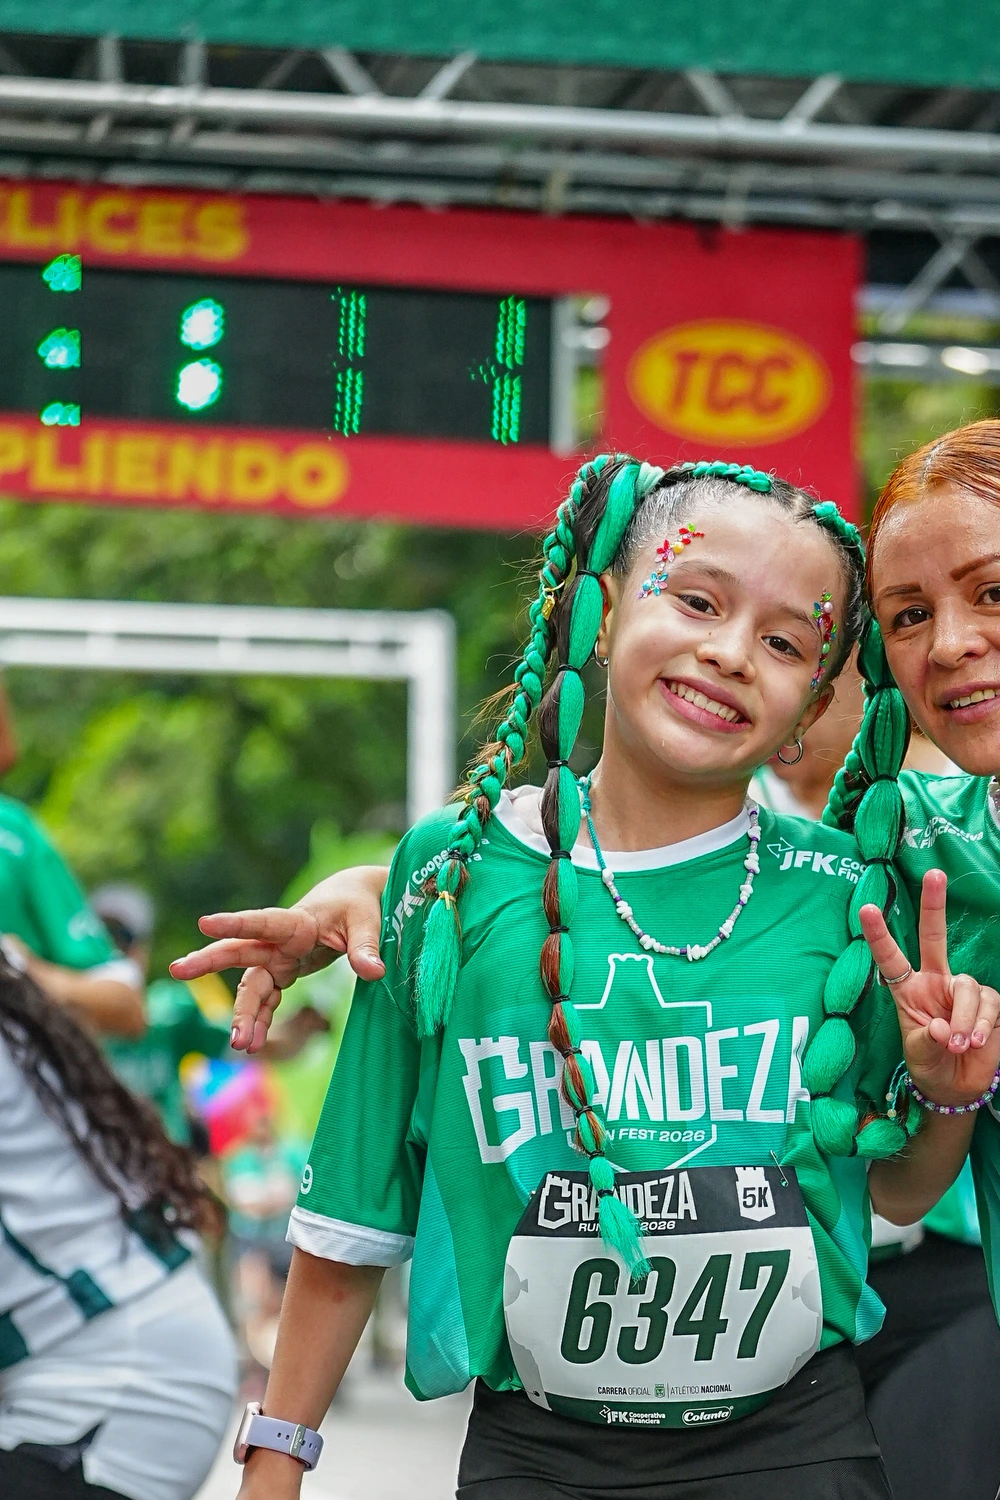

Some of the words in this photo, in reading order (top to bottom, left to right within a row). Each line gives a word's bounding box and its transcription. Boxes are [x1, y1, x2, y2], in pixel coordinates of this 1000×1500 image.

[0, 190, 249, 262] LICES
[670, 350, 794, 415] TCC
[780, 851, 839, 876] JFK
[618, 1129, 658, 1143] FEST
[659, 1129, 706, 1143] 2026
[742, 1186, 769, 1208] 5K
[640, 1220, 677, 1231] 2026
[560, 1249, 791, 1365] 6347
[597, 1386, 627, 1395] CARRERA
[628, 1386, 651, 1396] OFICIAL
[670, 1384, 700, 1395] ATLÉTICO
[701, 1384, 732, 1394] NACIONAL
[607, 1411, 630, 1424] JFK
[629, 1411, 666, 1419] Cooperativa
[629, 1417, 660, 1425] Financiera
[684, 1410, 730, 1422] Colanta
